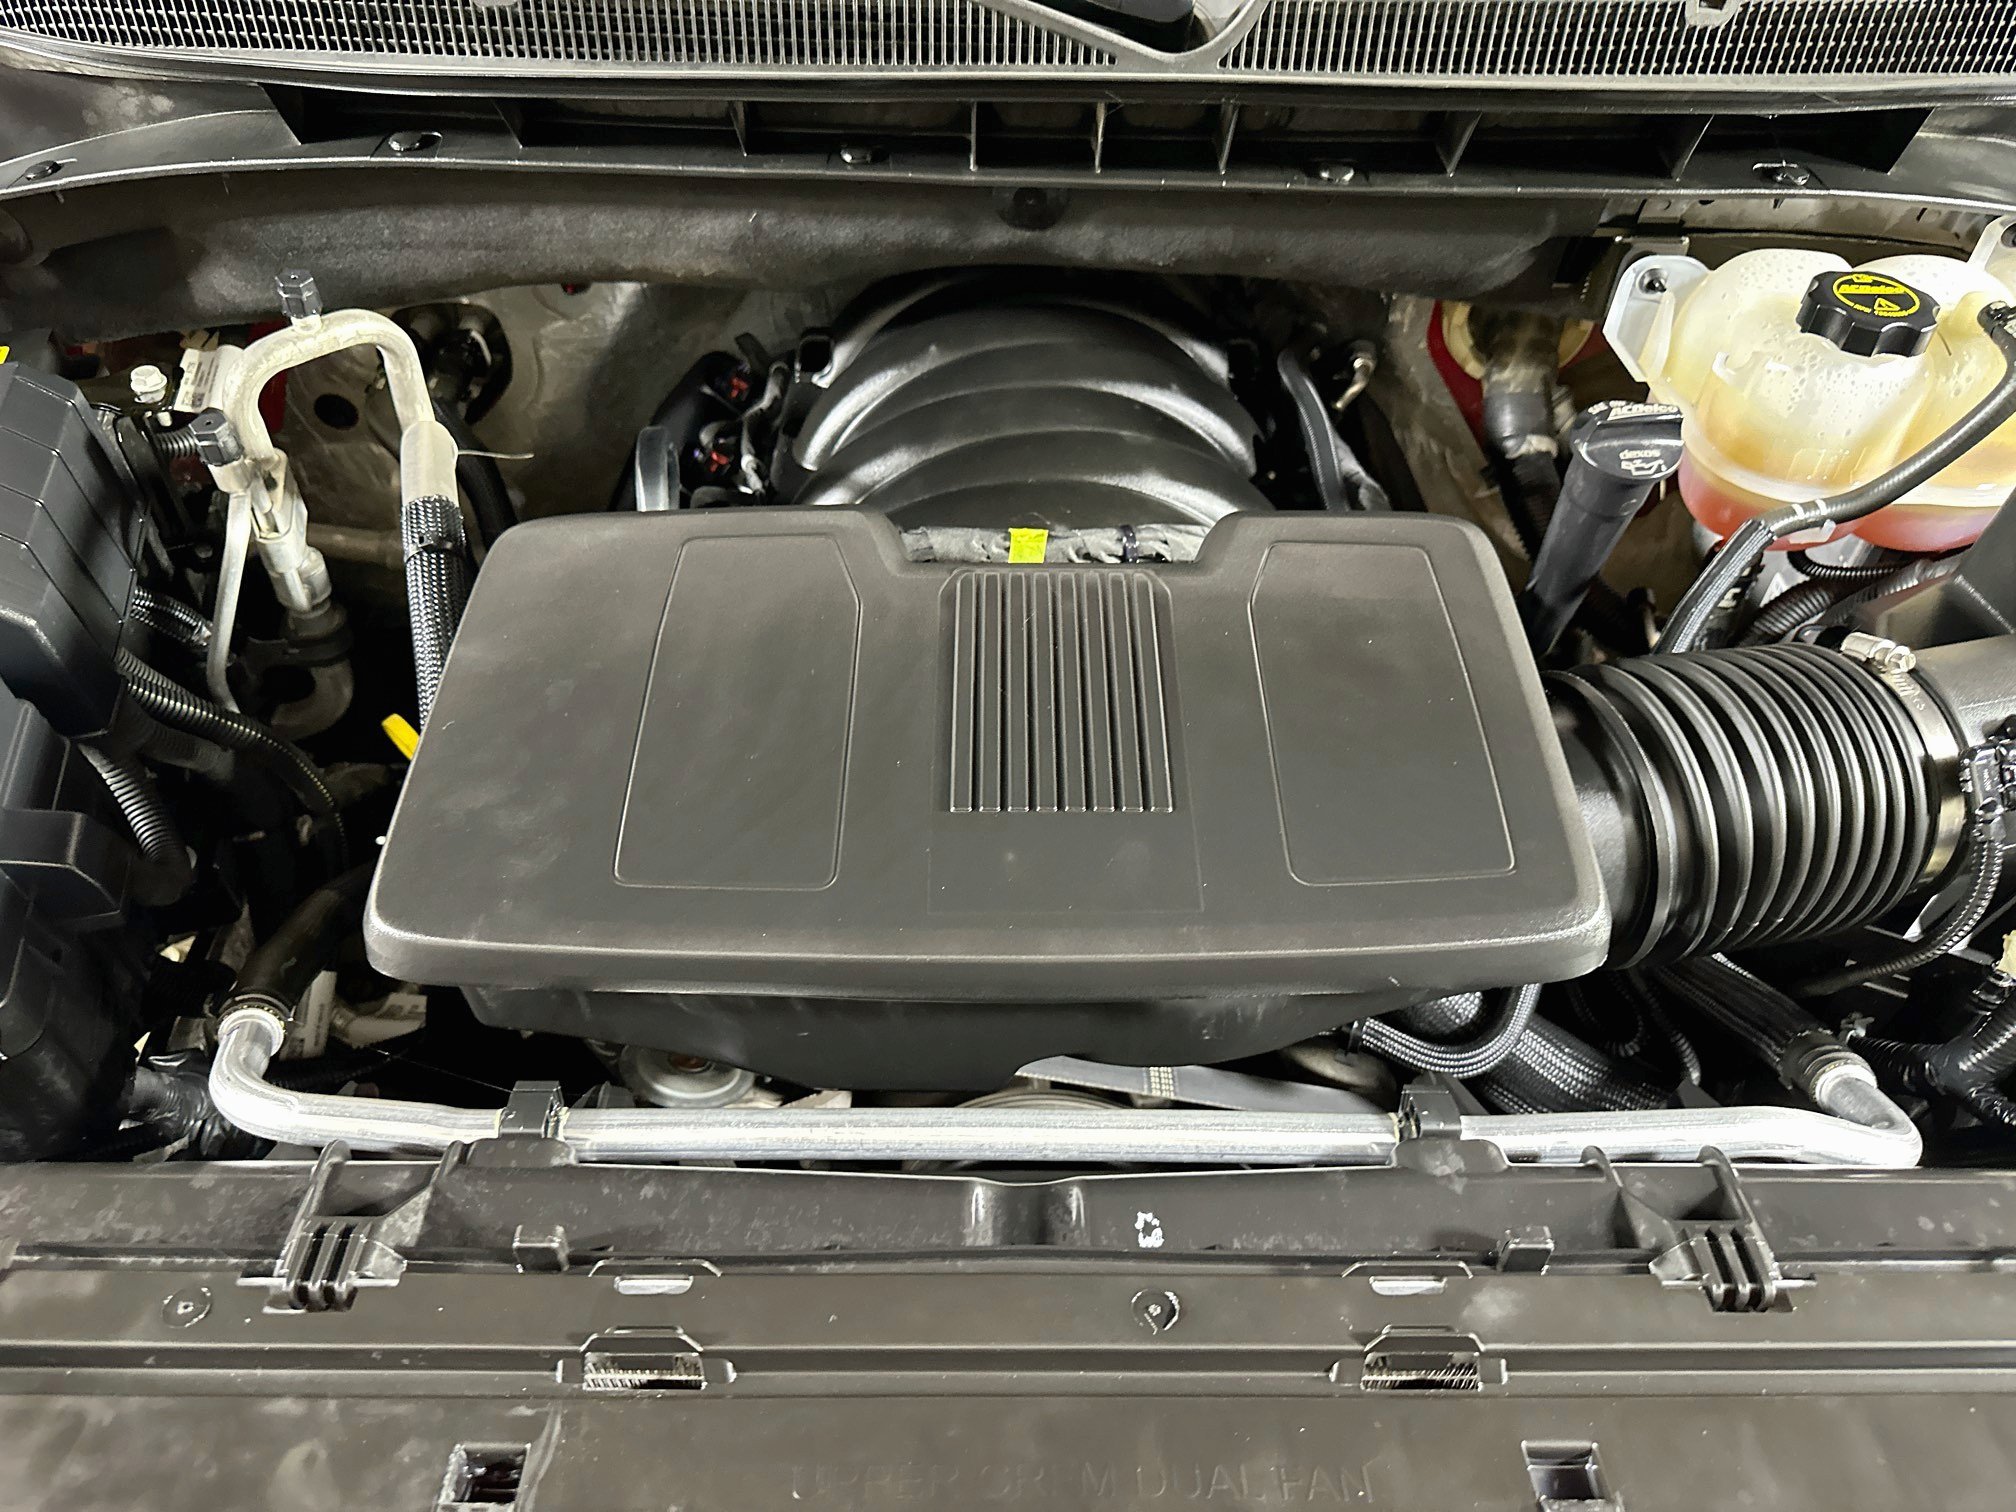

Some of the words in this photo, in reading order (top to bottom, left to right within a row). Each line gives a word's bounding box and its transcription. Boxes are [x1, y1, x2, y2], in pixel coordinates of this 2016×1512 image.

[1607, 403, 1679, 421] ACDelco
[1619, 449, 1661, 460] dexos
[1135, 1462, 1267, 1503] DUAL
[1280, 1463, 1375, 1503] FAN
